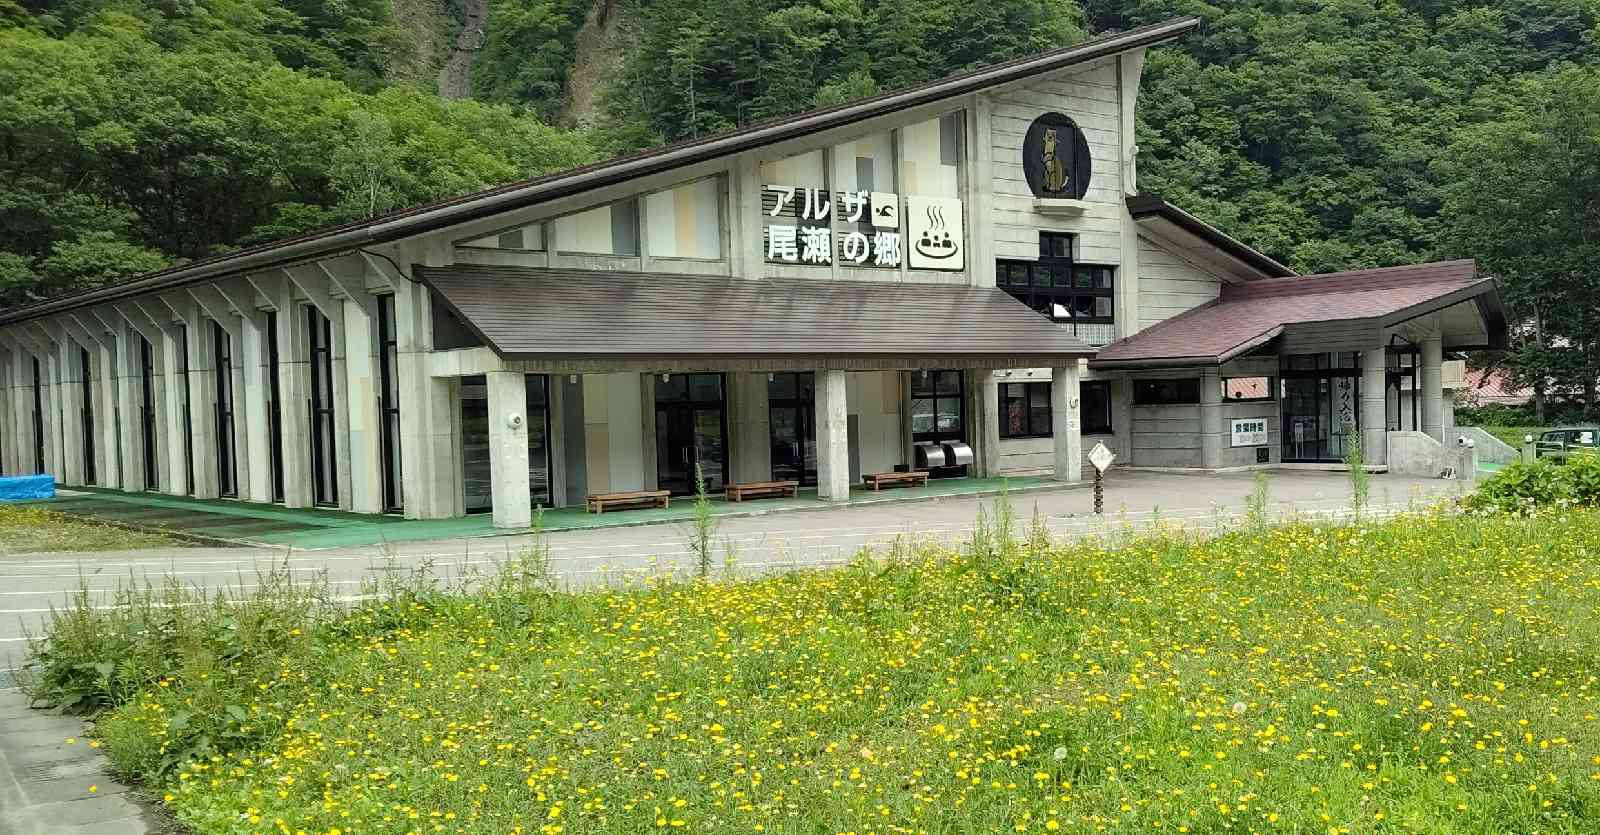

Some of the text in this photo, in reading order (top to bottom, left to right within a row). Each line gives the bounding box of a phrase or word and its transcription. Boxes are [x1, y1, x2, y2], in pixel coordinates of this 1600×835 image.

[767, 184, 869, 223] アルザ
[768, 225, 902, 266] 尾瀬の郷
